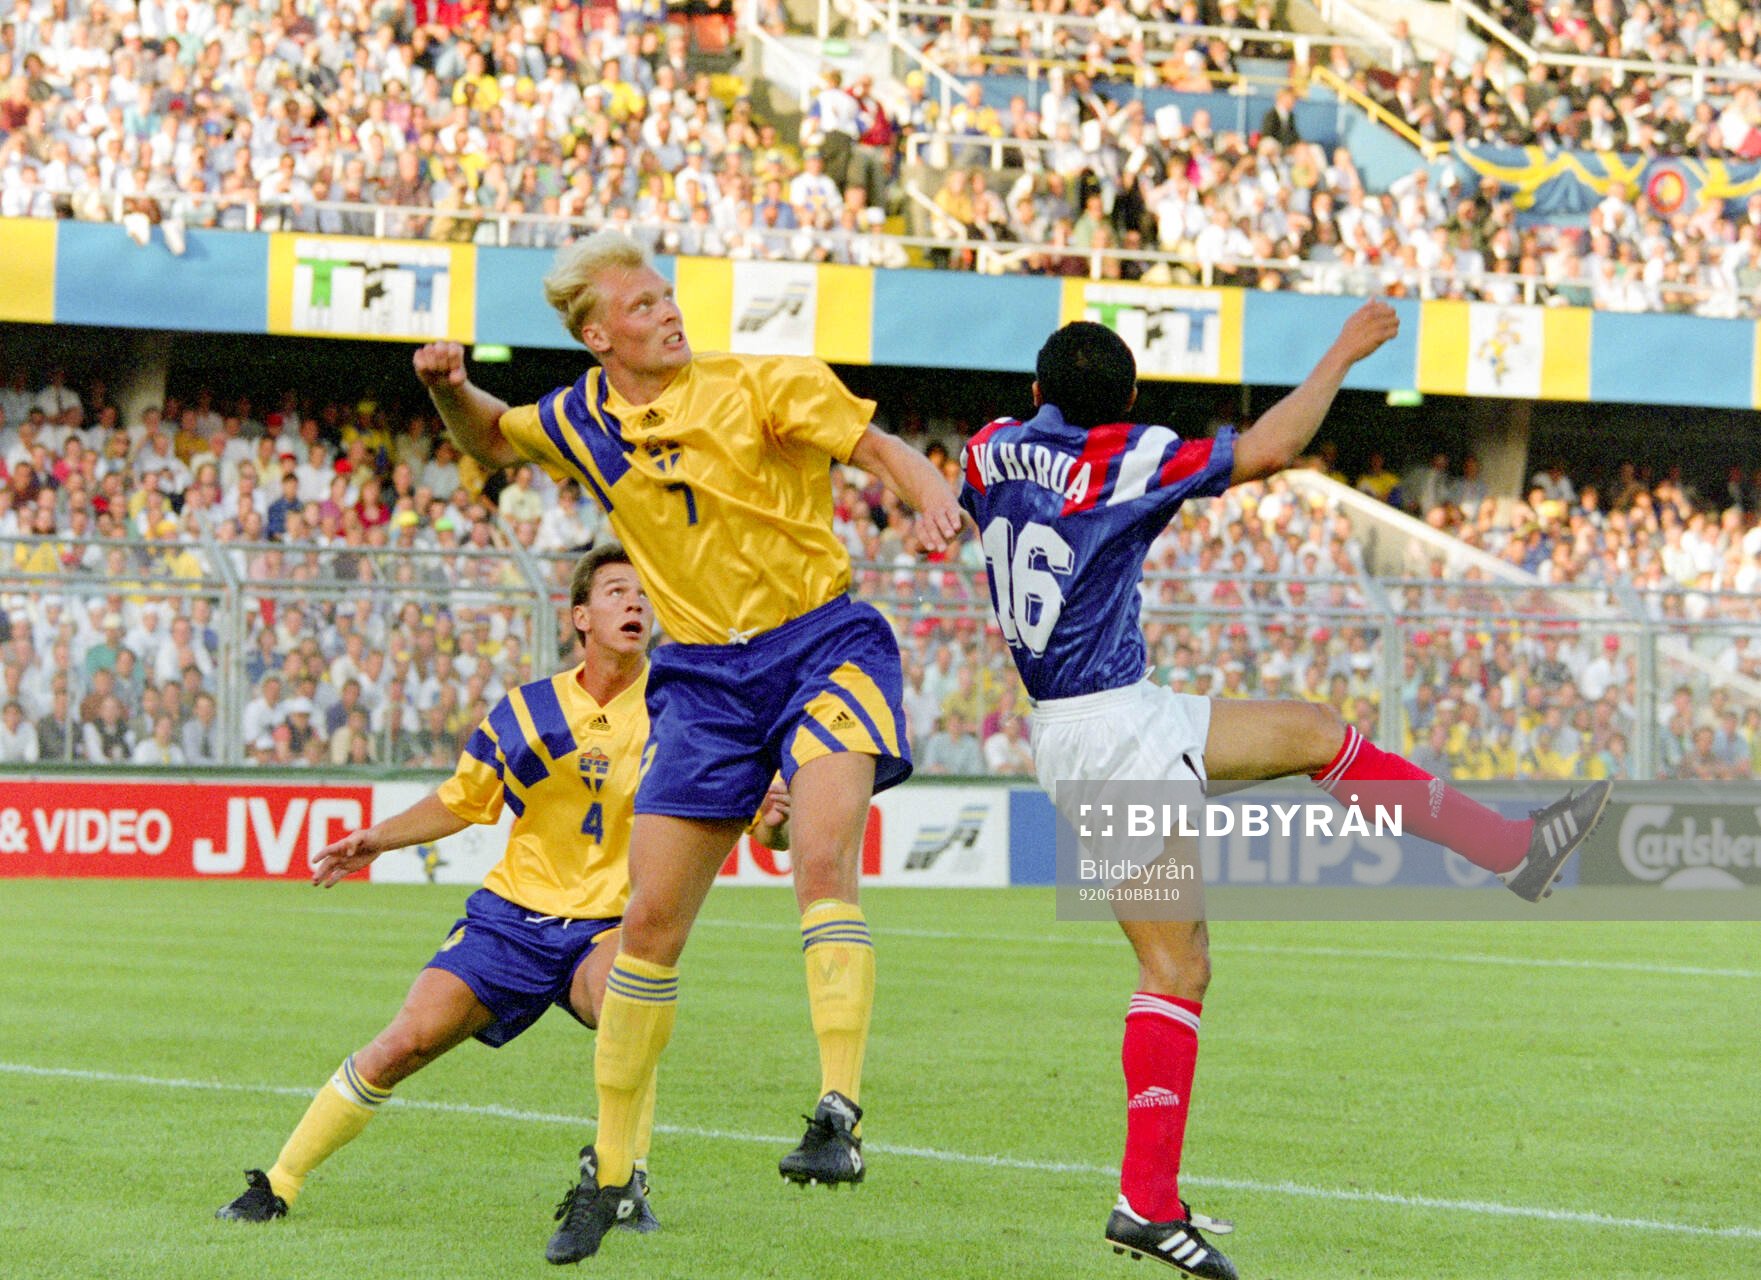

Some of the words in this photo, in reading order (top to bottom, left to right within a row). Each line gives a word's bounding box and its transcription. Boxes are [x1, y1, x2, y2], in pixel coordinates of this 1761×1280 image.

[664, 480, 699, 527] 7
[971, 440, 1092, 504] VAHIRUA
[981, 516, 1075, 659] 16
[0, 807, 29, 853] &
[32, 808, 173, 855] VIDEO
[192, 797, 363, 875] JVC
[580, 802, 604, 845] 4
[1078, 800, 1403, 884] ILIPS
